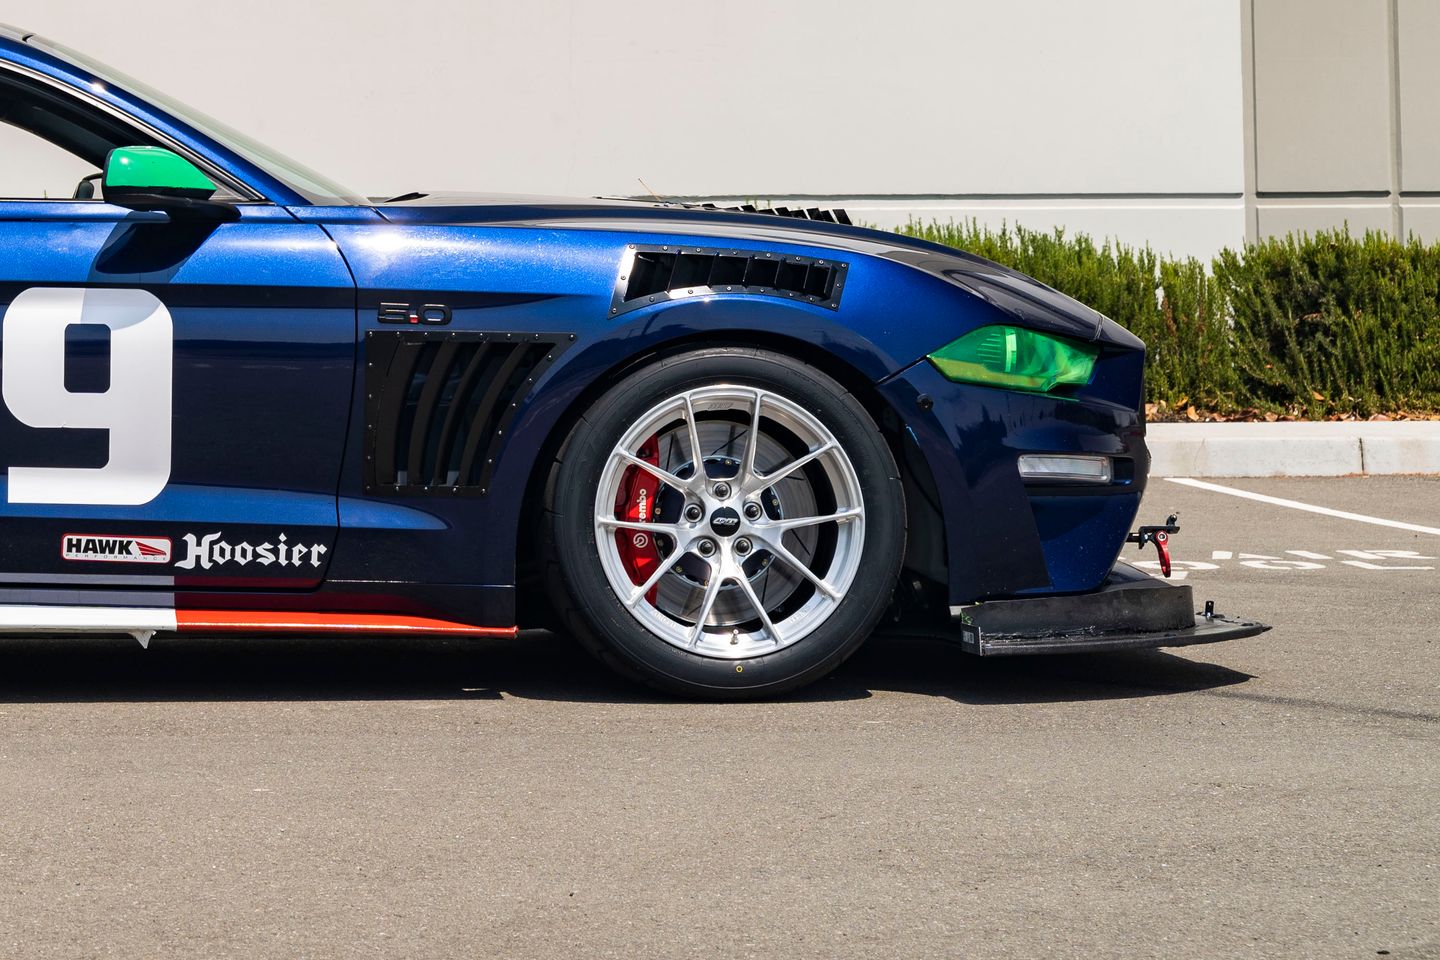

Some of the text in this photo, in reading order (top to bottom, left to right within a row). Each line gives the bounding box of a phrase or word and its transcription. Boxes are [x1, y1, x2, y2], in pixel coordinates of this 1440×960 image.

[377, 302, 452, 325] 5.0
[65, 553, 167, 561] PERFORMANCE
[66, 537, 134, 556] HAWK
[174, 531, 327, 570] Hoosier
